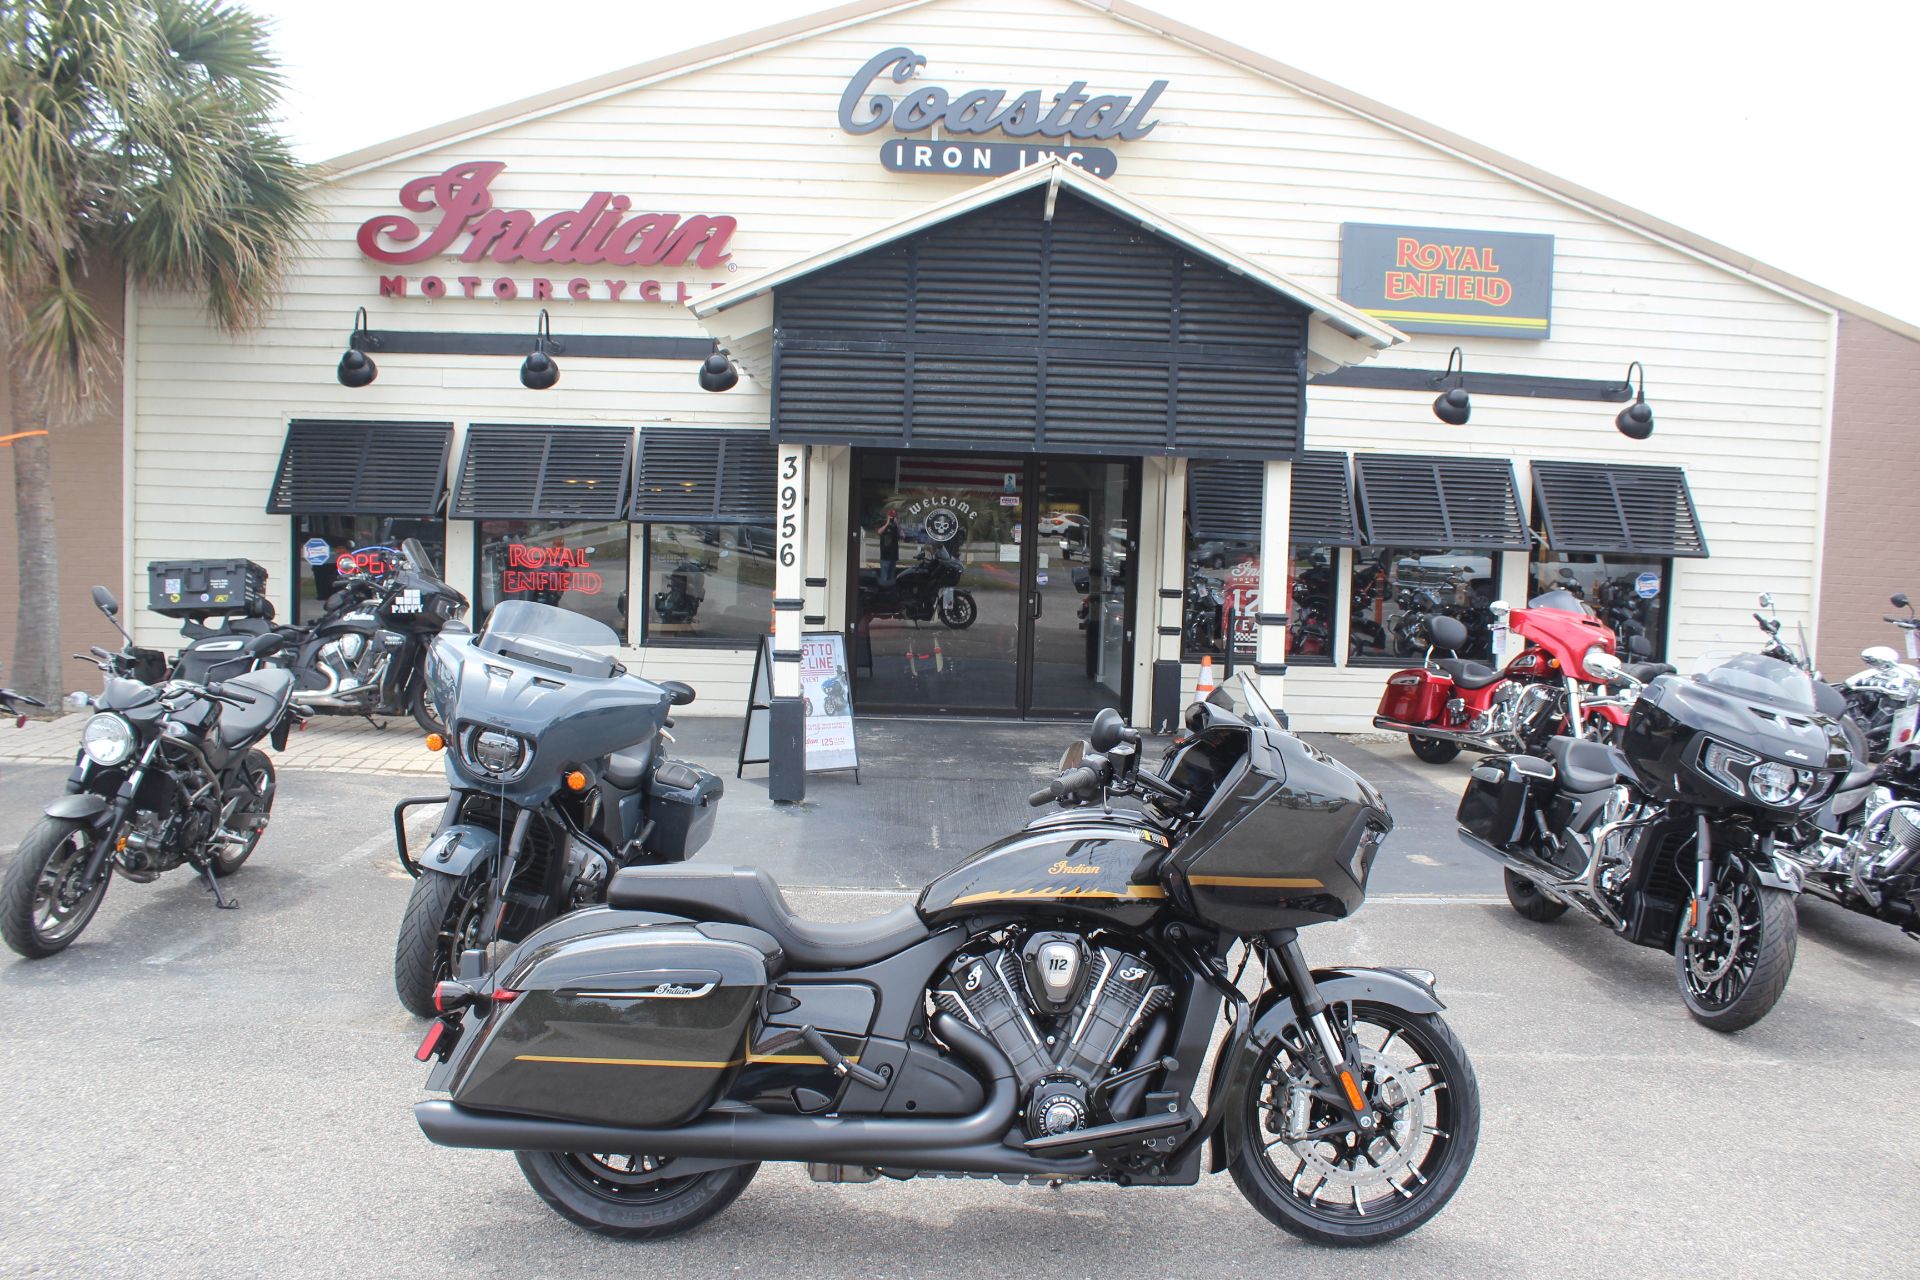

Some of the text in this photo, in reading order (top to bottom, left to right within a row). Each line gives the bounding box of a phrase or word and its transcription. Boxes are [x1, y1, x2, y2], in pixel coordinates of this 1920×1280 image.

[838, 47, 1170, 141] Coastal
[895, 145, 991, 169] IRON
[356, 161, 738, 269] Indian
[1396, 237, 1499, 272] ROYAL
[379, 275, 727, 302] MOTORCYCL
[1384, 271, 1512, 306] ENFIELD
[780, 456, 798, 567] 3956
[508, 543, 591, 569] ROYAL
[503, 570, 603, 595] ENFIELD
[391, 604, 423, 614] PAPPY
[818, 643, 833, 655] TO
[808, 657, 834, 669] LINE
[1047, 860, 1101, 875] Indian
[1049, 958, 1068, 971] 112
[654, 983, 692, 996] Indian
